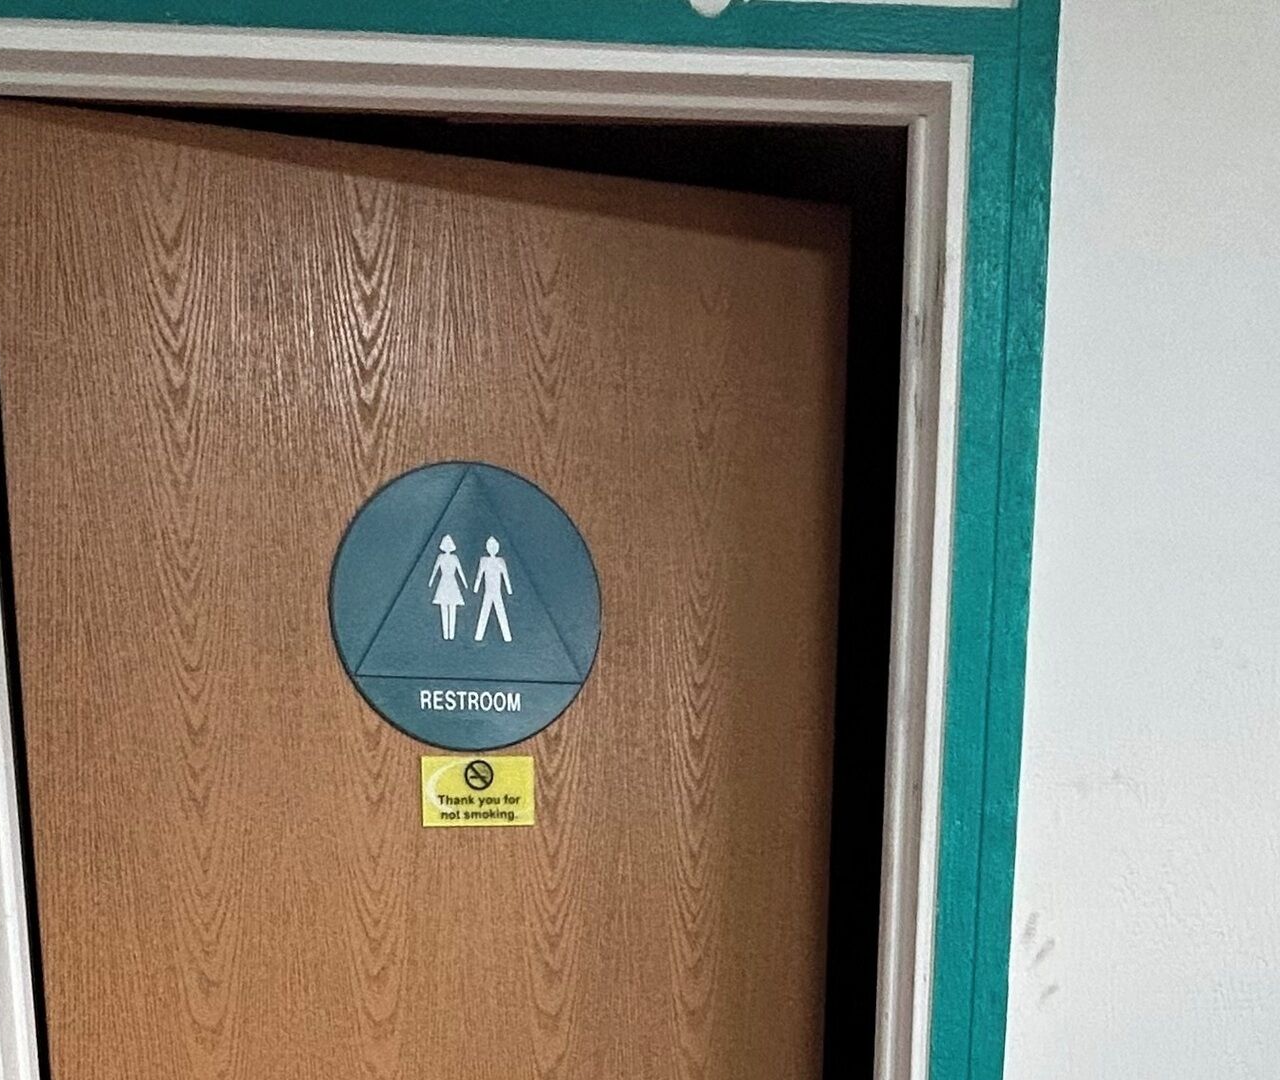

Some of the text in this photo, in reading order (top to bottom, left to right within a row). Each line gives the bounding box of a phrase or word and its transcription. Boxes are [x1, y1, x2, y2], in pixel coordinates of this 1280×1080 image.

[420, 689, 521, 712] RESTROOM
[438, 794, 521, 808] Thank you for
[440, 810, 461, 820] not
